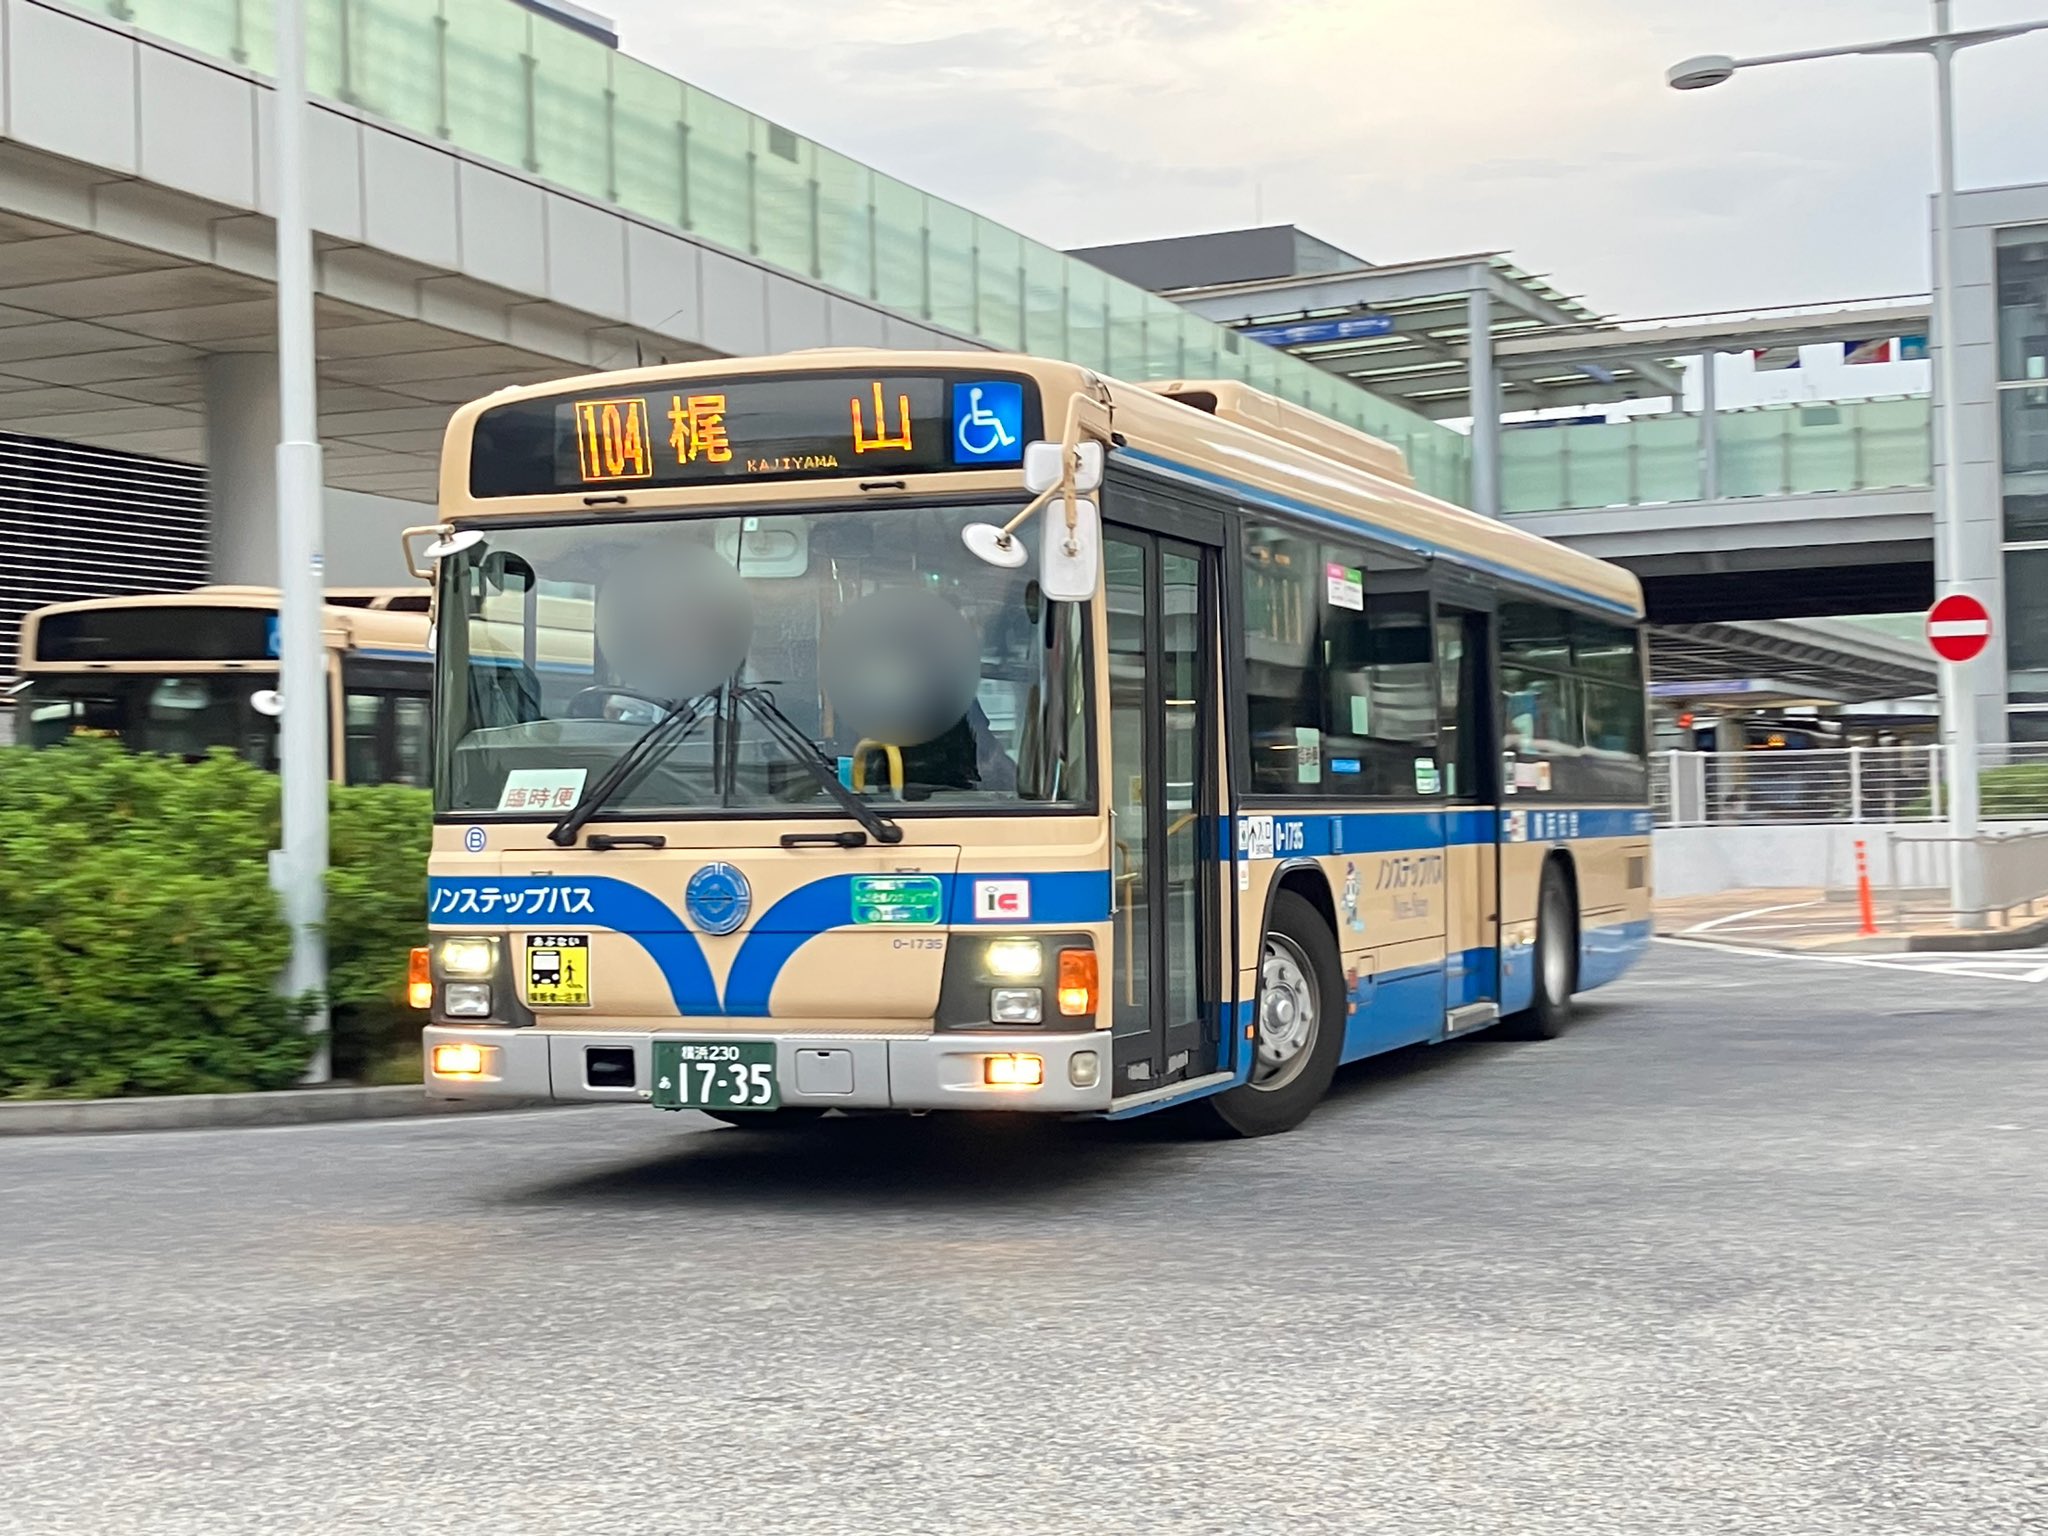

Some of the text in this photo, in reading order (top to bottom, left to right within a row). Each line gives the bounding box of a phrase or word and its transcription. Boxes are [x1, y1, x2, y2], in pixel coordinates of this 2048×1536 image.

[584, 402, 644, 477] 104
[667, 381, 913, 464] 梶 山
[747, 455, 839, 472] KAJIYAMA
[504, 787, 576, 808] 臨時便
[431, 887, 595, 914] ノンステップバス
[658, 1062, 772, 1104] あ 17-35
